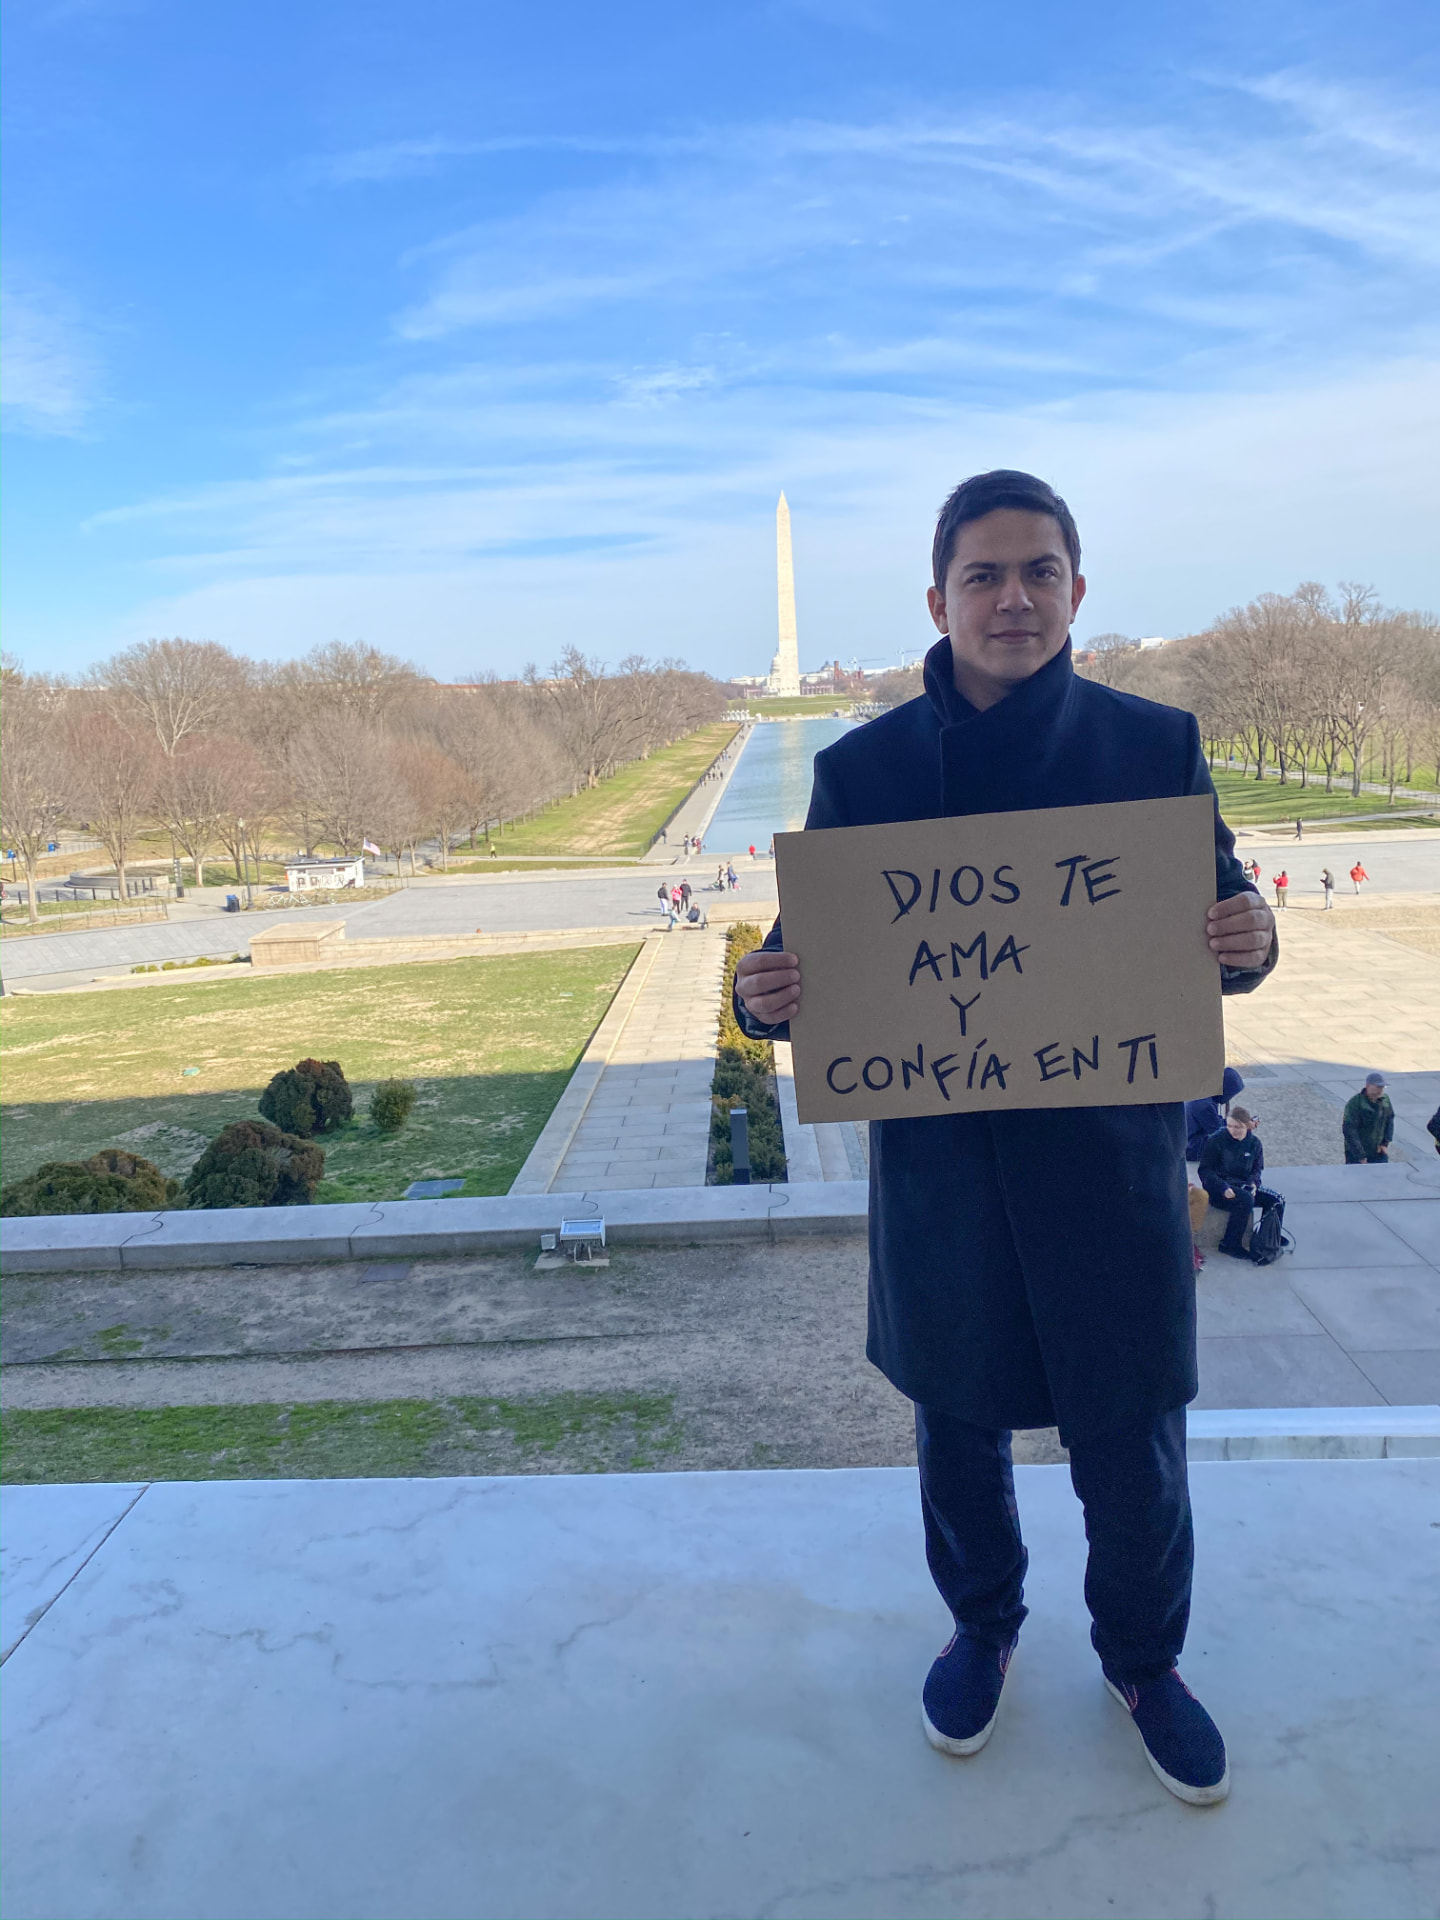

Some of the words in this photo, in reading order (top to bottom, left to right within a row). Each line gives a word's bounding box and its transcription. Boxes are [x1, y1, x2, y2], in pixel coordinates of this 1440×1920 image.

[881, 865, 1021, 924] DIOS
[1055, 855, 1121, 906] TE
[909, 931, 1031, 986] AMA
[950, 992, 981, 1036] Y
[827, 1038, 1011, 1101] CONFÍA
[1034, 1035, 1099, 1082] EN
[1118, 1033, 1159, 1084] TI
